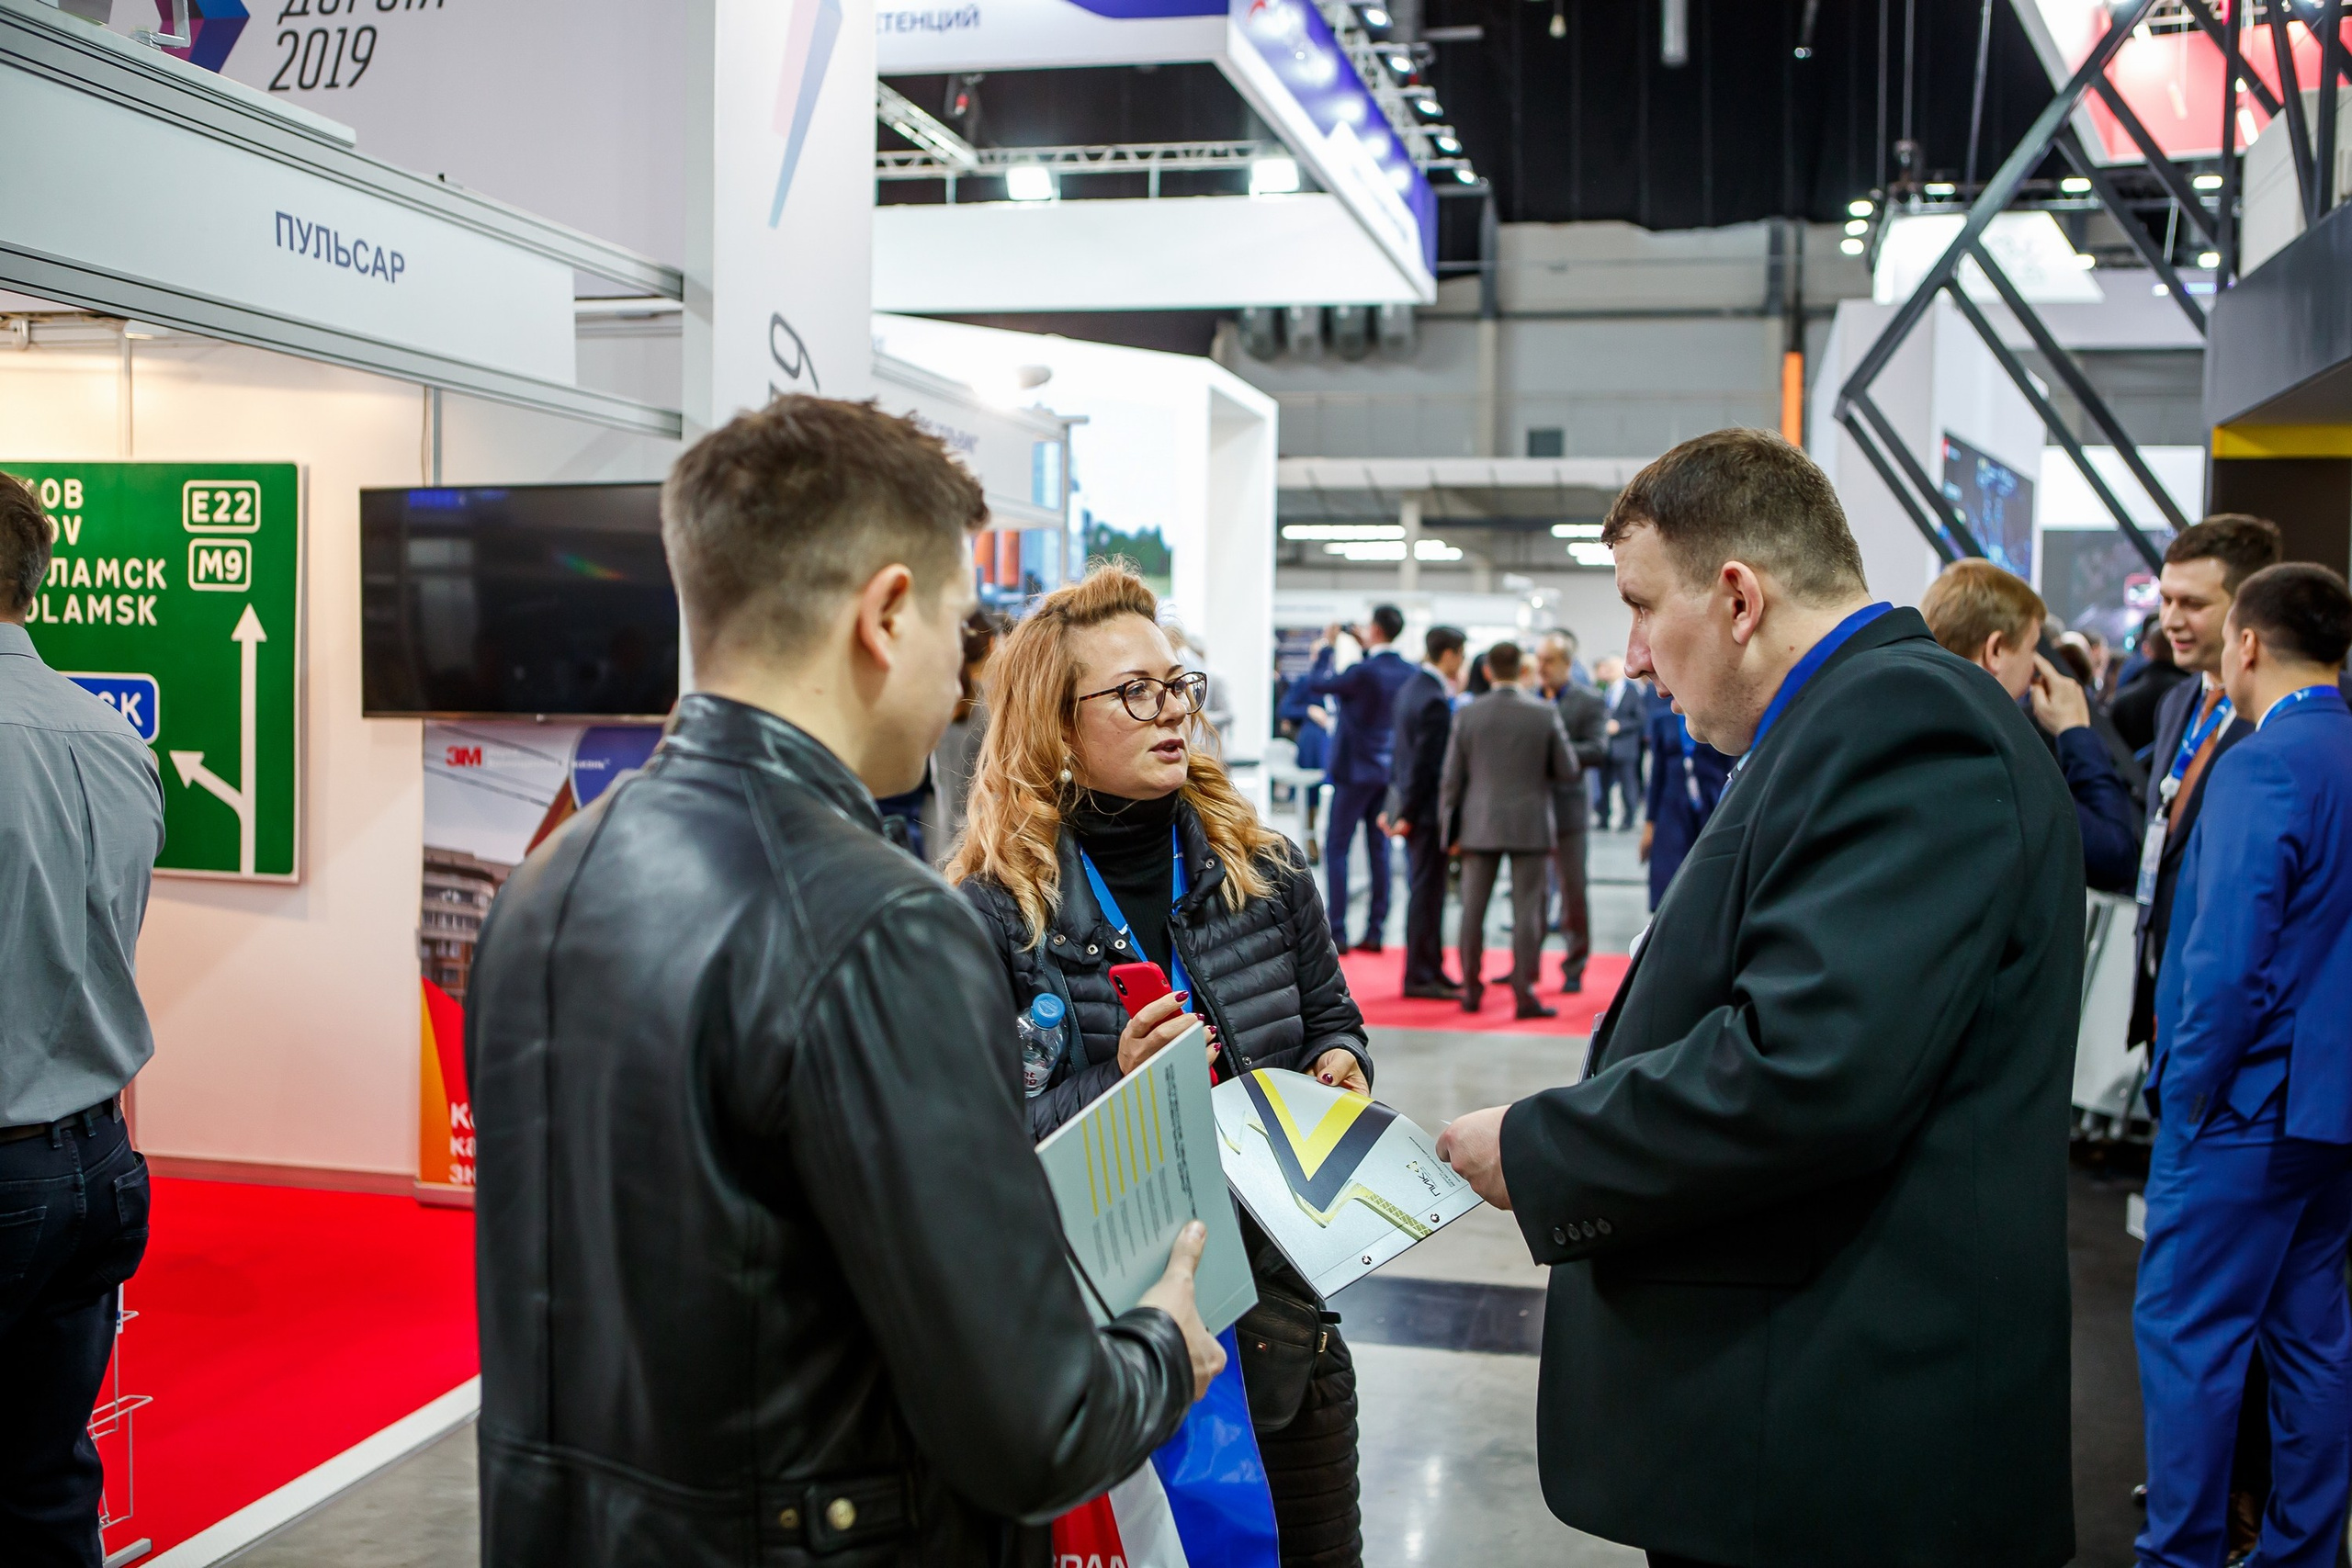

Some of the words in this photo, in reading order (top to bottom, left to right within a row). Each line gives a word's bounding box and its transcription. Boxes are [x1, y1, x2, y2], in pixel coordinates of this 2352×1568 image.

[268, 25, 377, 91] 2019
[276, 210, 405, 284] ПУЛЬСАР
[27, 478, 84, 509] ОВ
[191, 491, 252, 523] E22
[198, 549, 243, 581] M9
[446, 746, 483, 766] 3M
